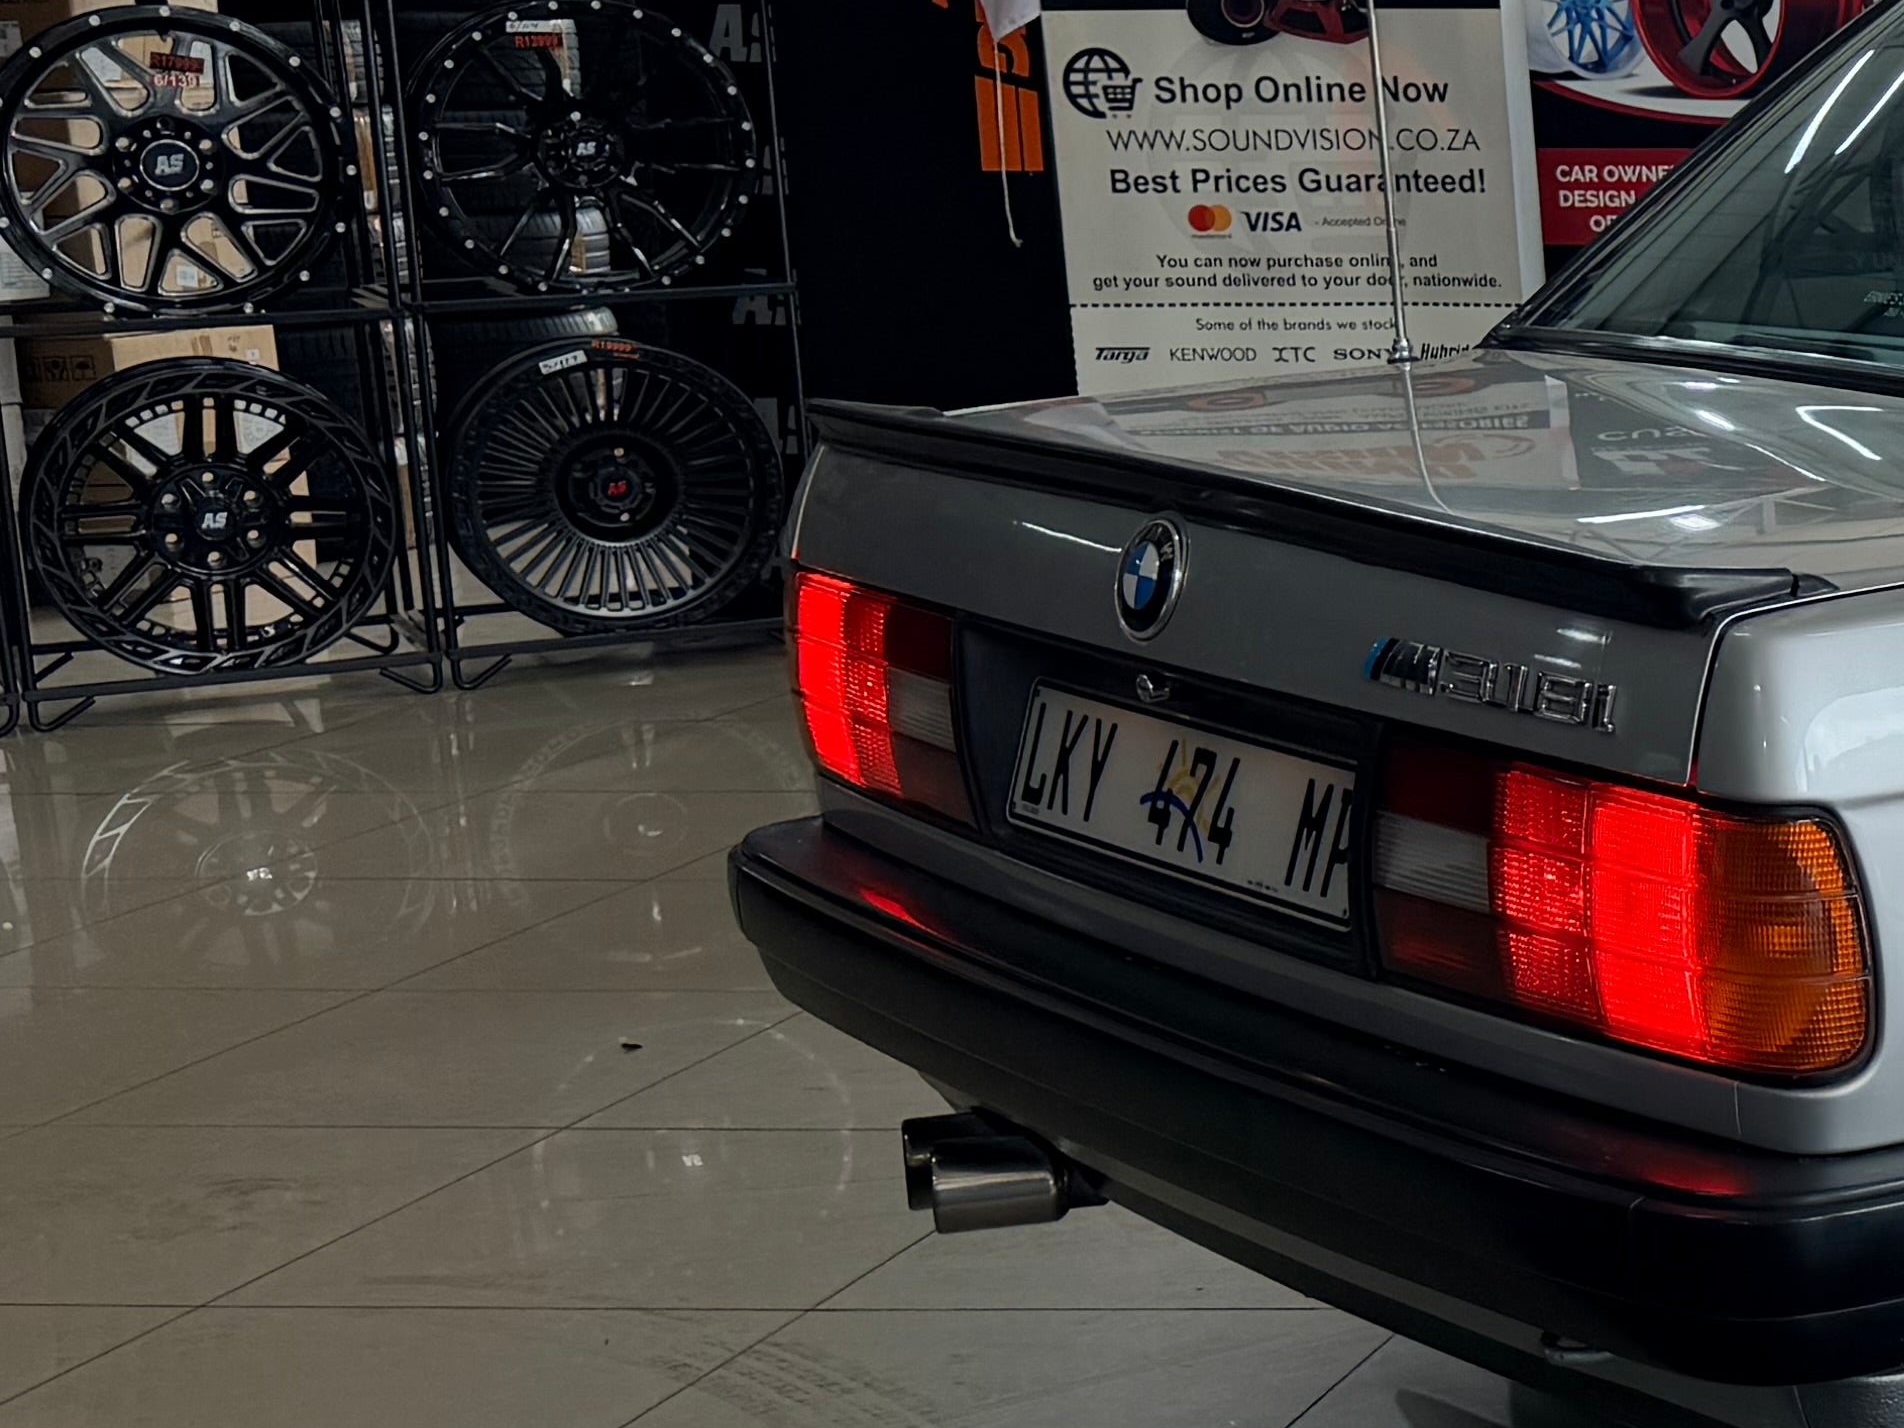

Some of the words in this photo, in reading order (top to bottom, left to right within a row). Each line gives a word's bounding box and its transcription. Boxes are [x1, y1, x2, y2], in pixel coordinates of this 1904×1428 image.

[1154, 75, 1243, 108] Shop
[1254, 74, 1365, 102] Online
[1380, 76, 1448, 102] Now
[1107, 128, 1479, 152] WWW.SOUNDVISION.CO.ZA
[155, 154, 184, 175] AS
[1110, 168, 1181, 194] Best
[1191, 168, 1287, 194] Prices
[1559, 190, 1636, 207] DESIGN
[1241, 211, 1301, 231] VISA
[1156, 254, 1188, 269] You
[1195, 257, 1223, 268] can
[1228, 257, 1261, 267] now
[1267, 255, 1343, 270] purchase
[1349, 254, 1404, 269] onlin,
[1409, 255, 1437, 267] and
[1093, 275, 1119, 291] get
[1123, 278, 1158, 291] your
[1165, 274, 1217, 288] sound
[1222, 274, 1295, 288] delivered
[1301, 275, 1317, 287] to
[1323, 276, 1359, 290] your
[1413, 274, 1501, 288] nationwide.
[1196, 318, 1234, 331] Some
[1239, 318, 1252, 331] of
[1257, 318, 1278, 331] the
[1284, 318, 1331, 331] brands
[1337, 321, 1356, 331] we
[1362, 318, 1396, 331] stock
[1020, 701, 1119, 823] LKY
